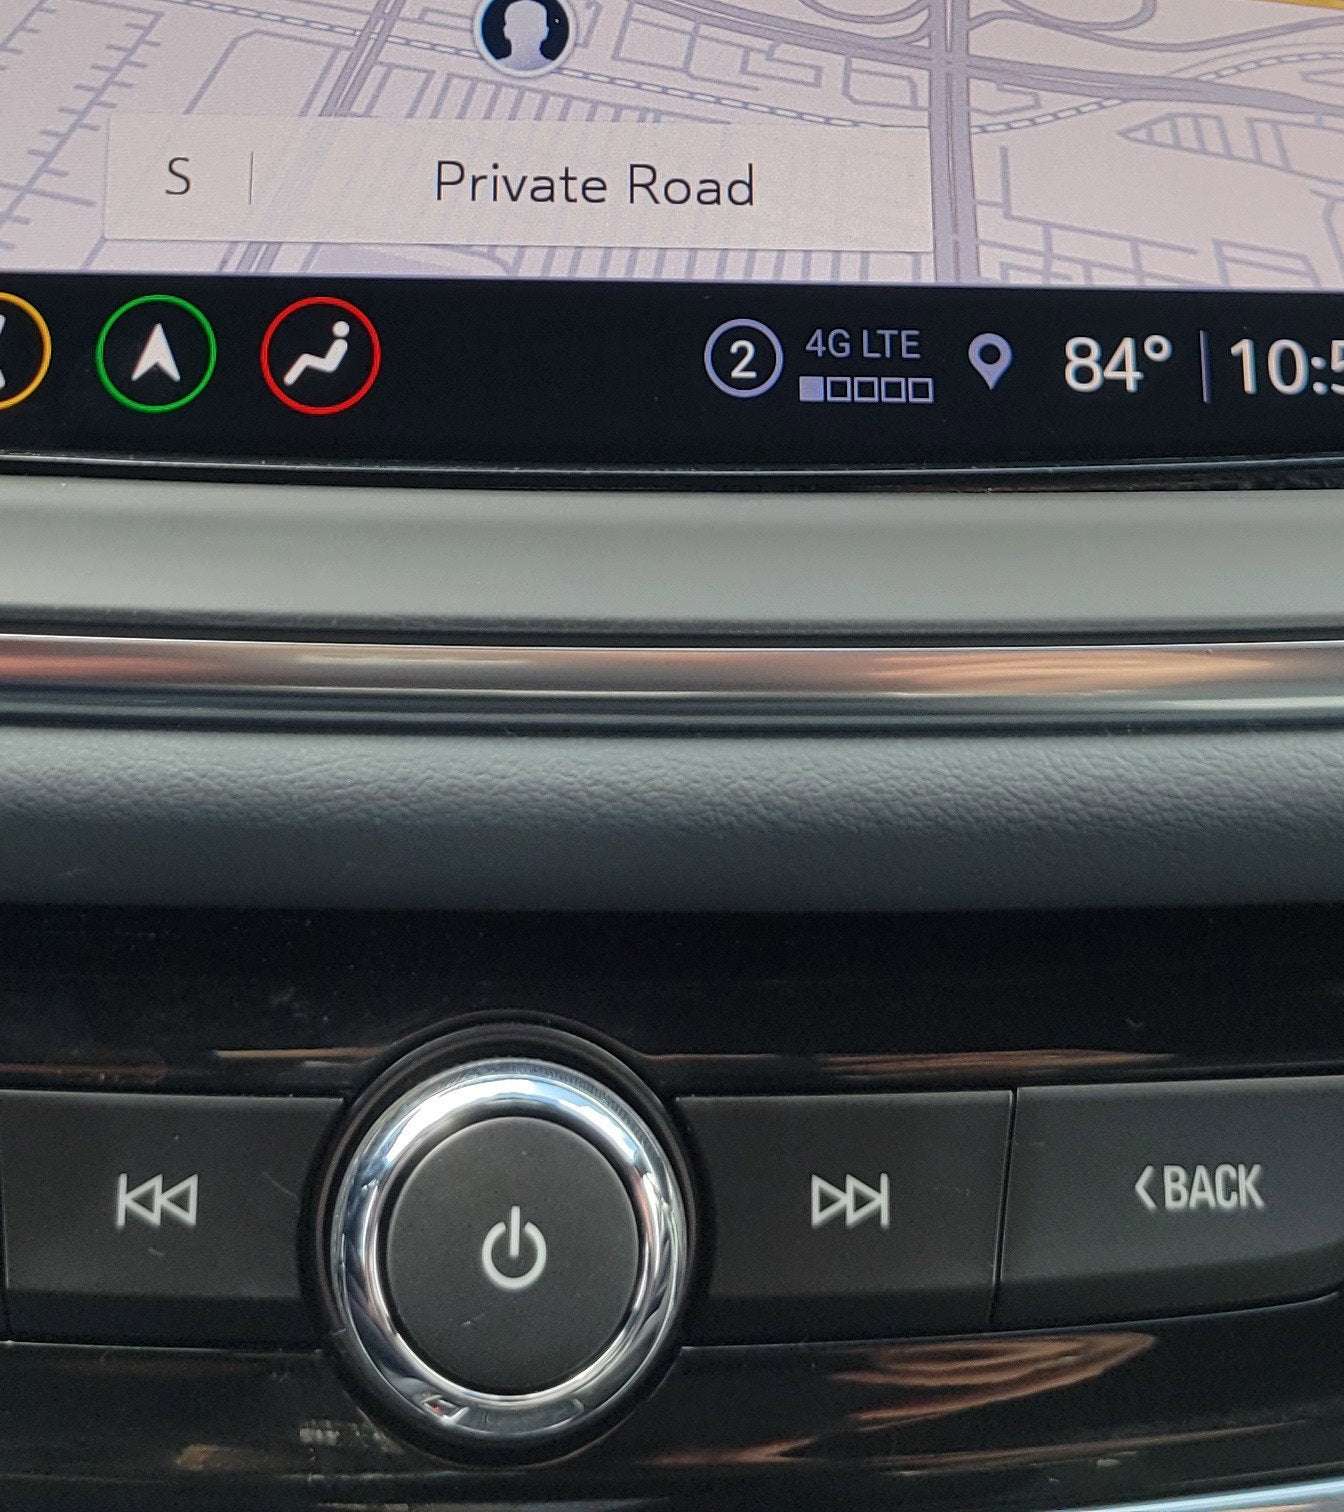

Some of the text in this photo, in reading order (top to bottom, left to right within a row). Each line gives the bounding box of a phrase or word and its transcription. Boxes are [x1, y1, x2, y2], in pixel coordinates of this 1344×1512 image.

[164, 156, 192, 196] S
[436, 160, 756, 206] Private Road
[729, 339, 758, 379] 2
[805, 328, 921, 360] 4G LTE
[1163, 1163, 1266, 1210] BACK
